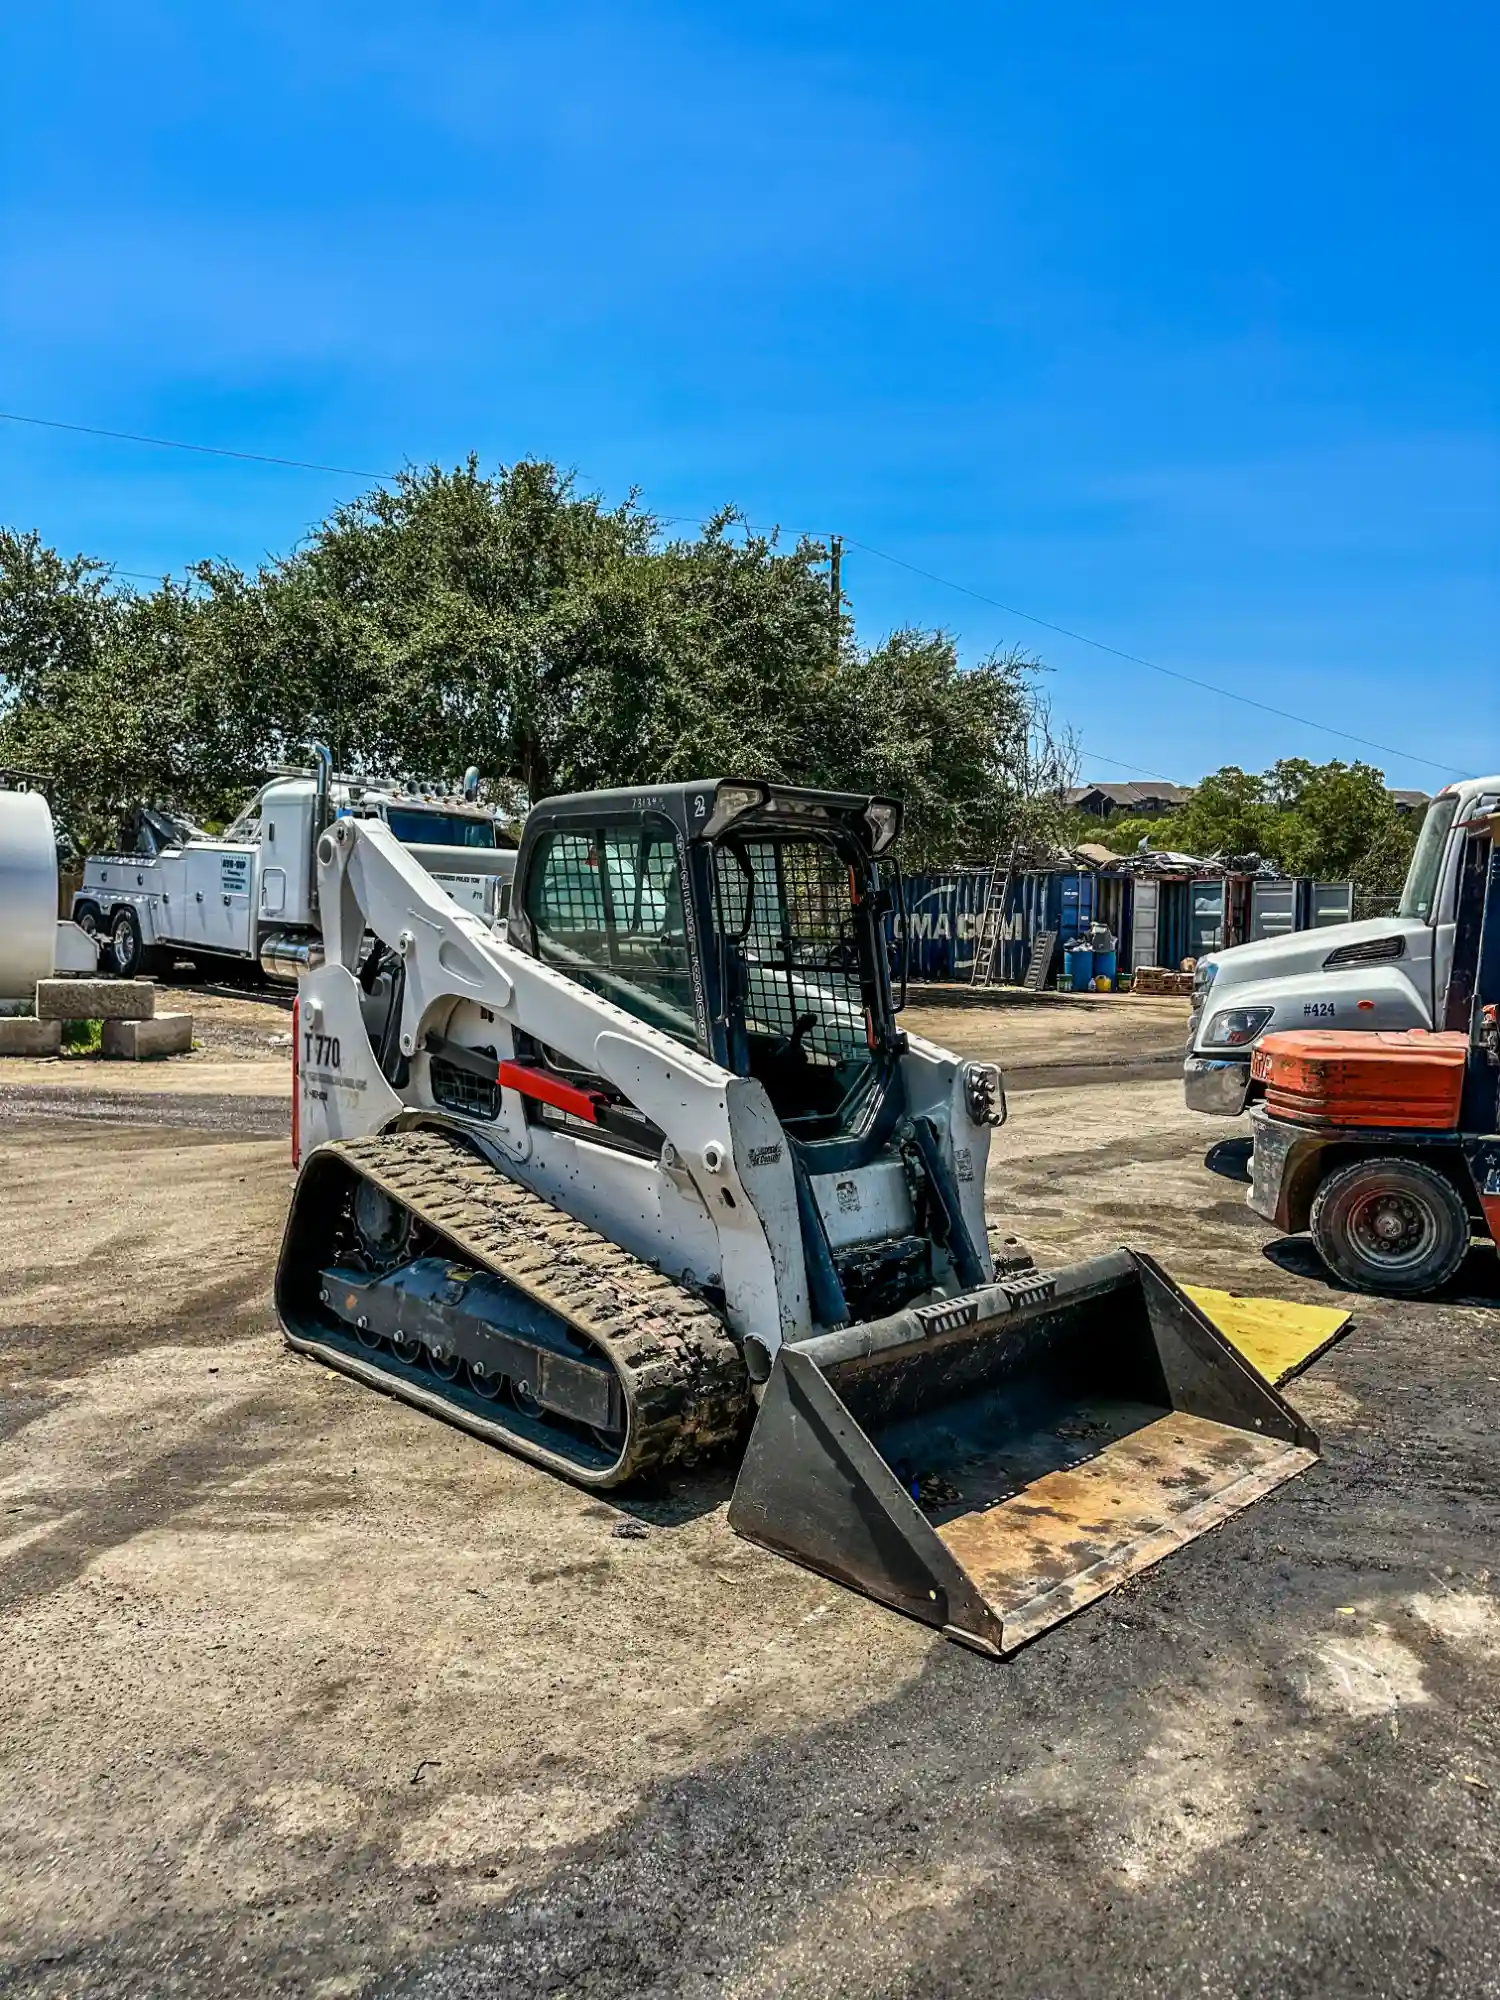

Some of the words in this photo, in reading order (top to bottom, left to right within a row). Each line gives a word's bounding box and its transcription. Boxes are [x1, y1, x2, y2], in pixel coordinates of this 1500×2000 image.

[694, 795, 705, 817] 2
[893, 912, 952, 940] CMA
[1303, 1002, 1336, 1017] #424
